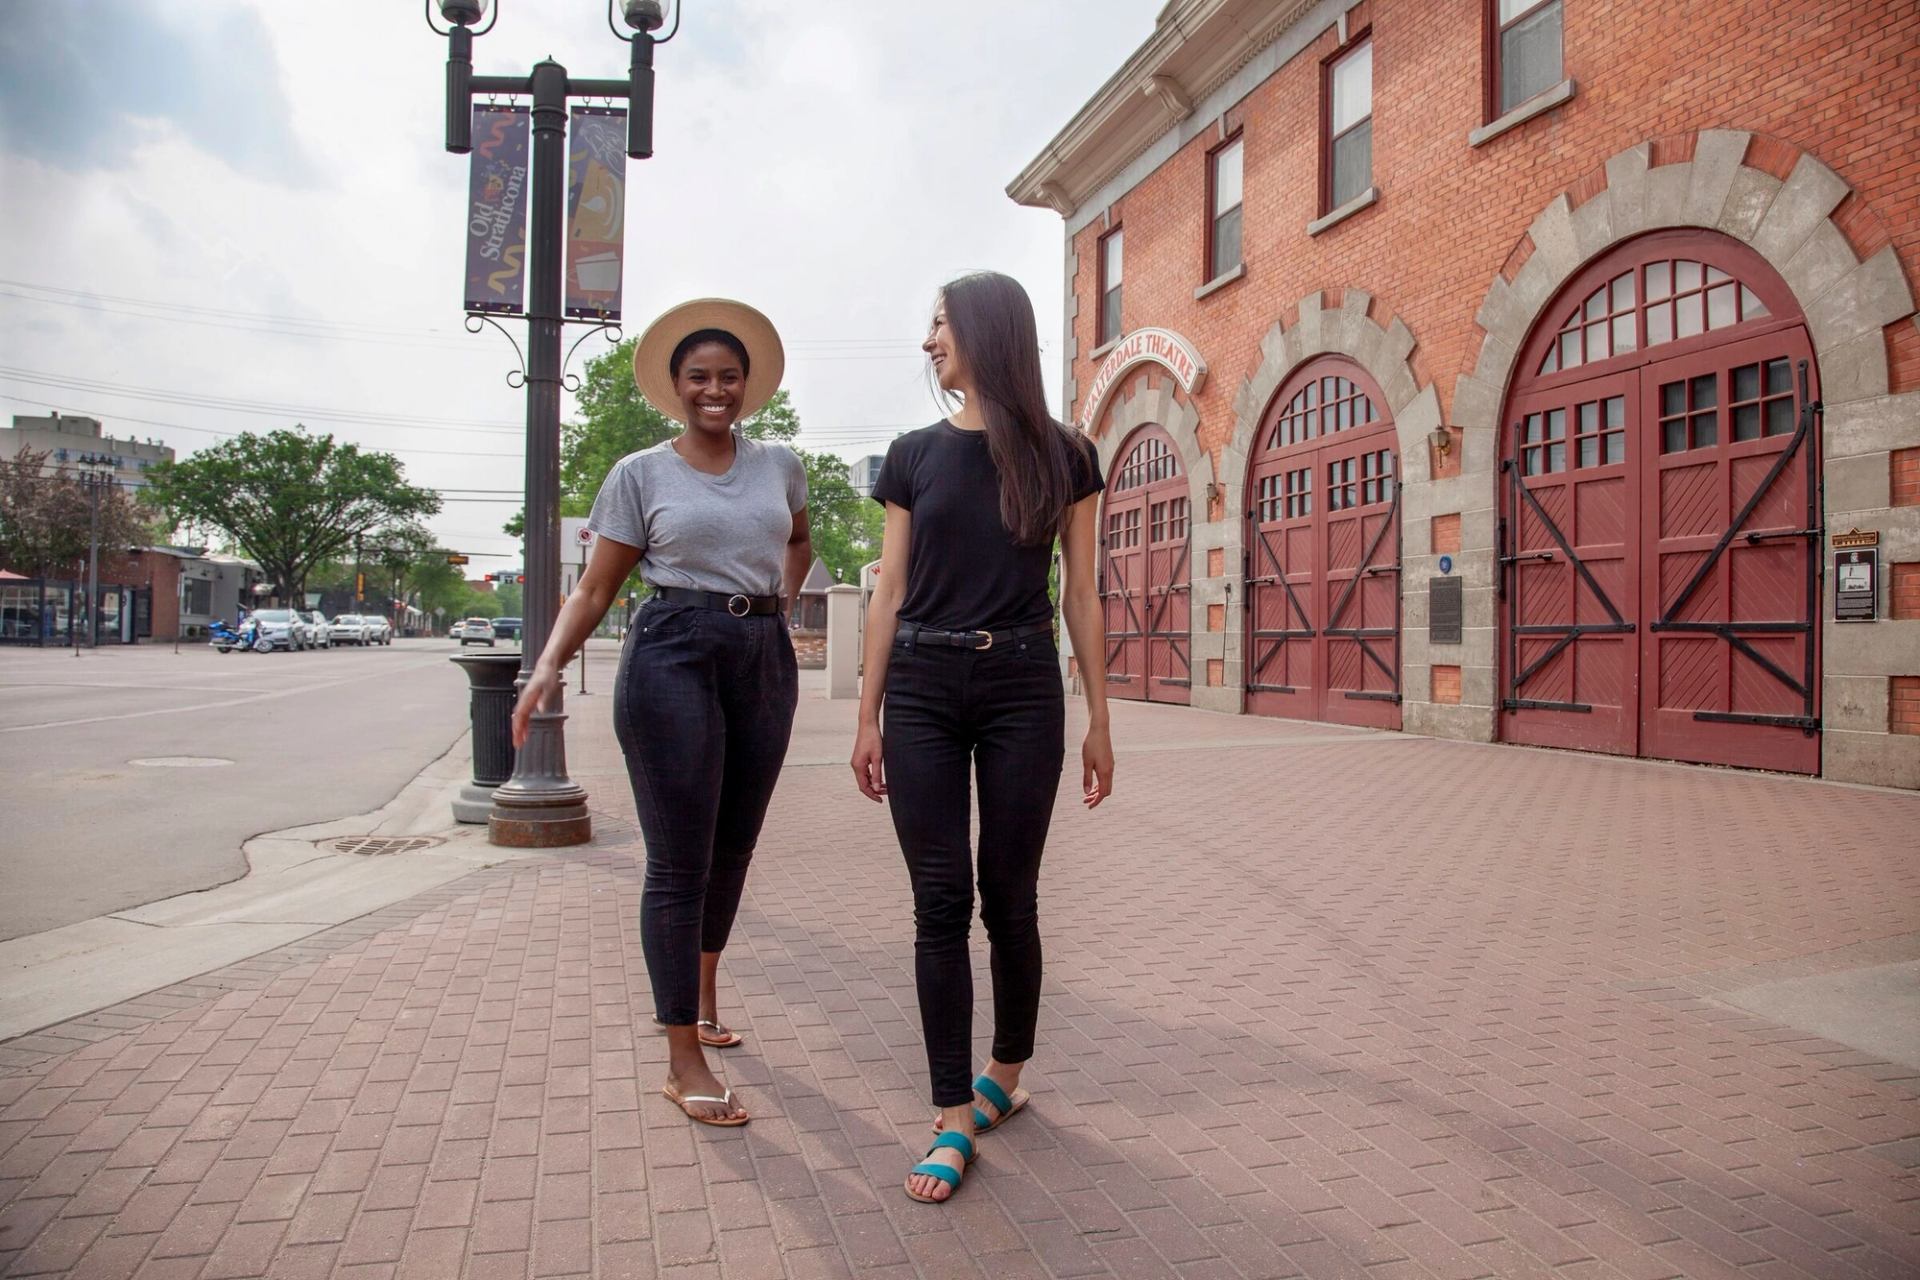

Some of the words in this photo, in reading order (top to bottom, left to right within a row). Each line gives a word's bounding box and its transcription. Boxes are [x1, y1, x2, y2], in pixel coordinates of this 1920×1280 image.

[470, 202, 494, 238] Old
[480, 166, 527, 261] Strathcona
[1083, 335, 1143, 424] WALTERDALE
[1145, 334, 1194, 383] THEATRE
